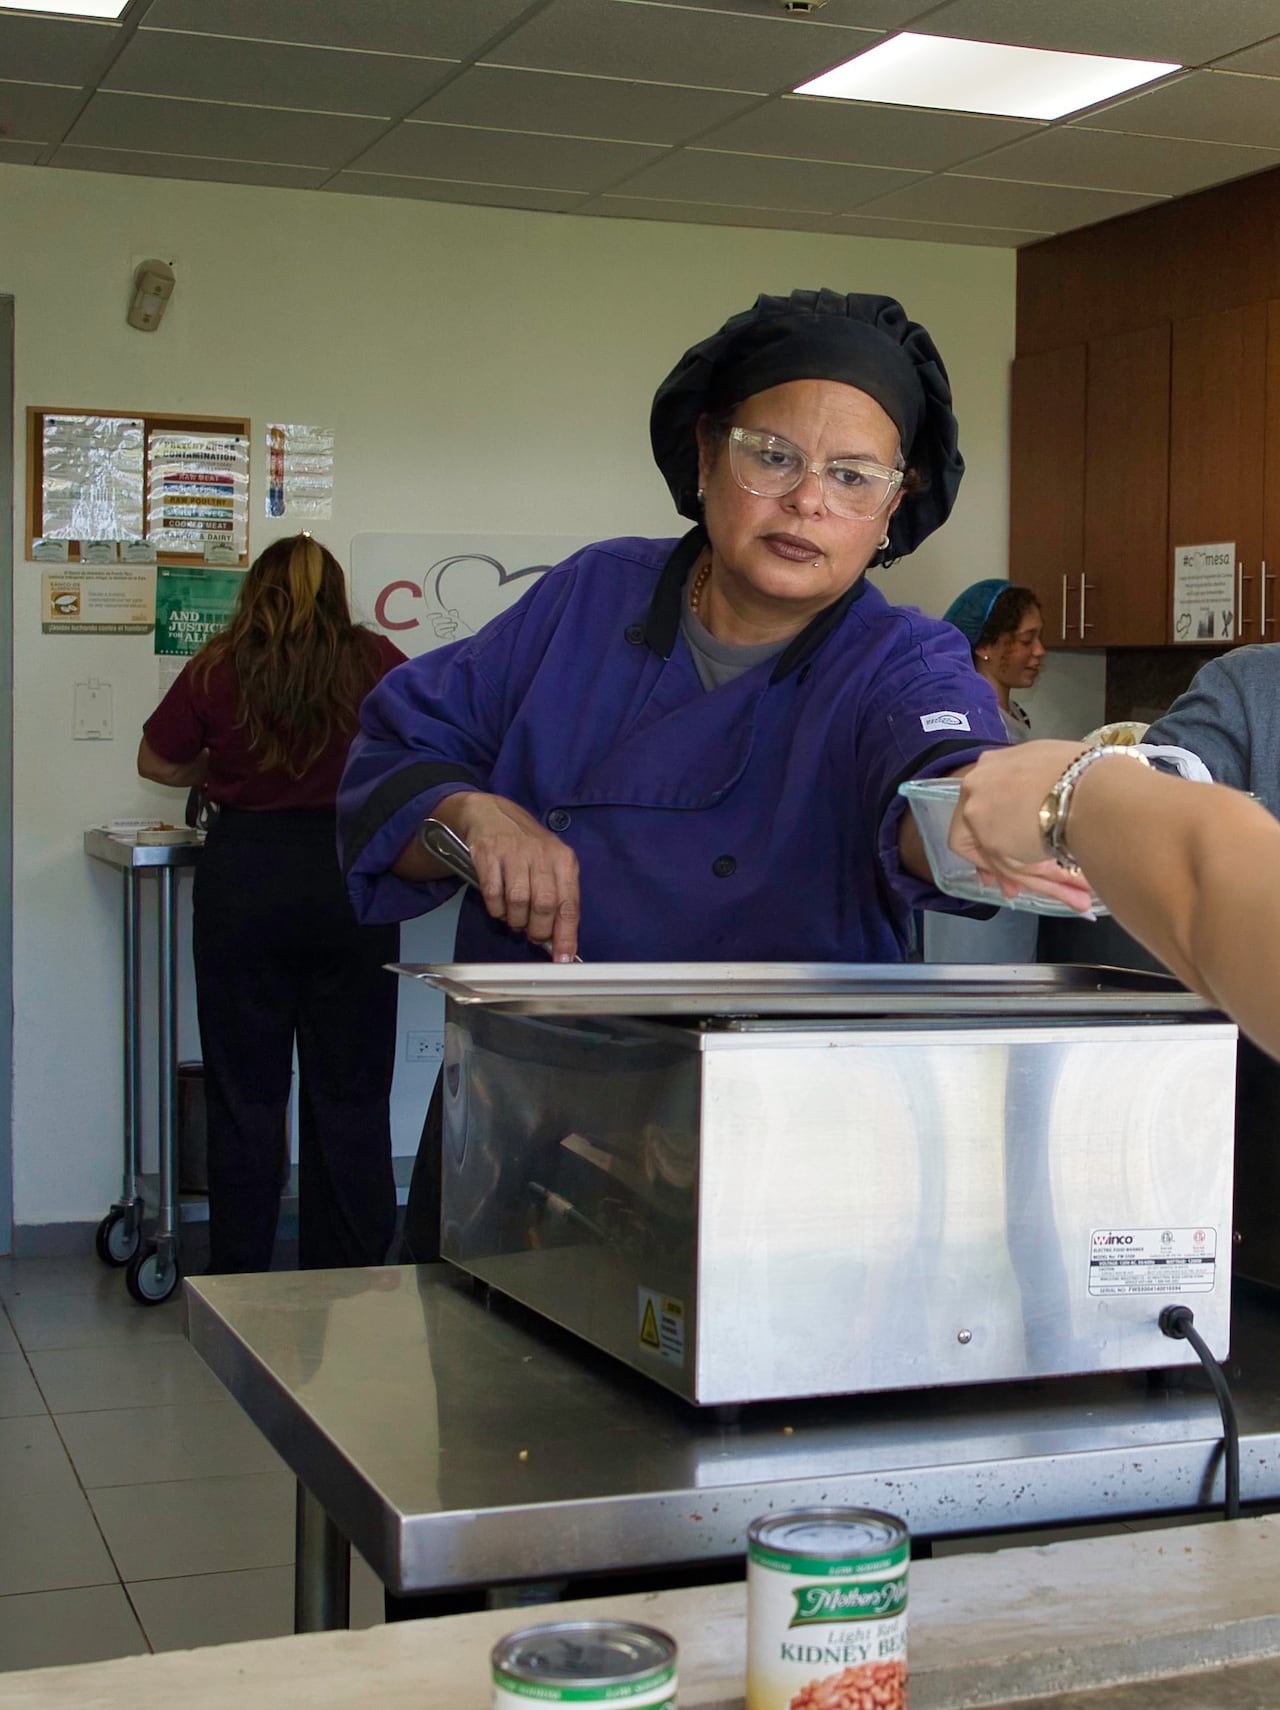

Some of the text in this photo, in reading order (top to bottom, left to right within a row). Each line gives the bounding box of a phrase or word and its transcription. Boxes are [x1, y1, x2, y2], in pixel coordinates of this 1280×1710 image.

[163, 451, 236, 461] CONTAMINATION
[169, 495, 226, 506] RAW POULTRY
[169, 520, 227, 529] COOKED MEAT
[207, 533, 231, 541] DAIRY
[169, 610, 200, 622] AND
[828, 1630, 872, 1646] Light
[780, 1642, 872, 1665] KIDNEY
